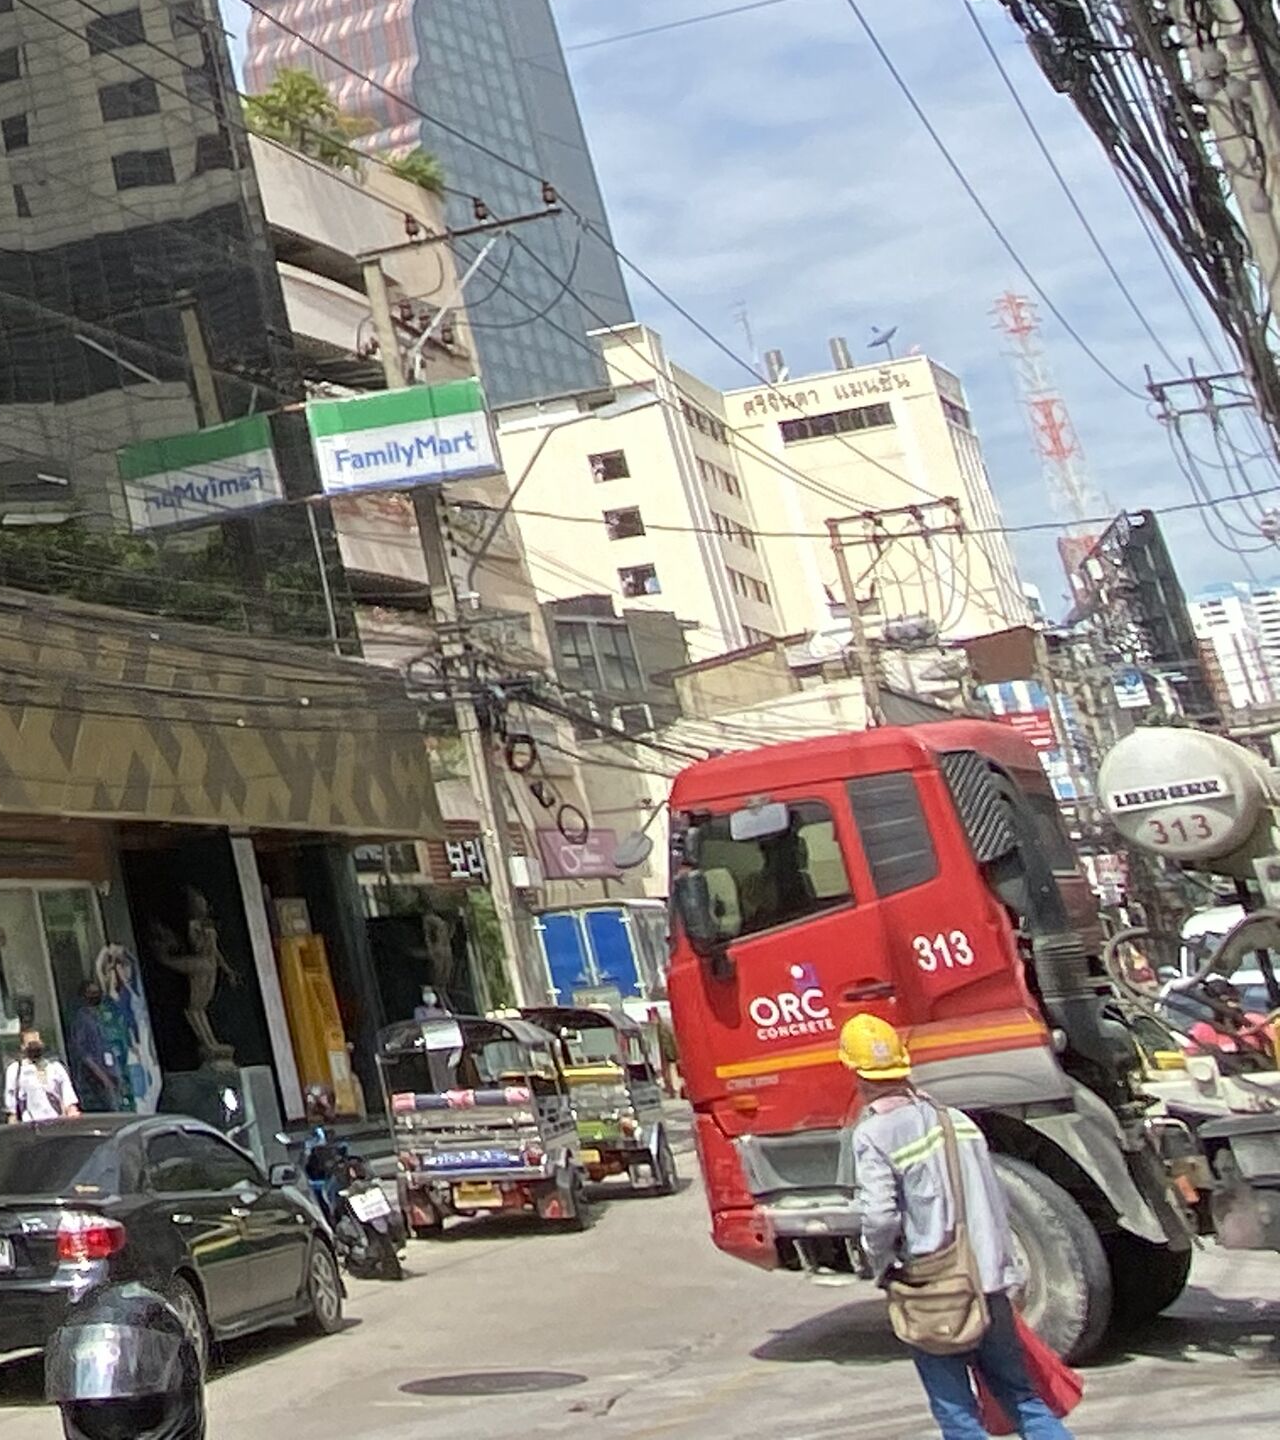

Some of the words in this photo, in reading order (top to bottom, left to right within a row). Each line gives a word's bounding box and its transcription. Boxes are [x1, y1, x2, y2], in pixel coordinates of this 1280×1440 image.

[335, 430, 476, 472] FamilyMart
[1147, 813, 1214, 845] 313
[911, 929, 975, 972] 313
[749, 988, 831, 1027] ORC
[756, 1017, 836, 1041] CONCRETE
